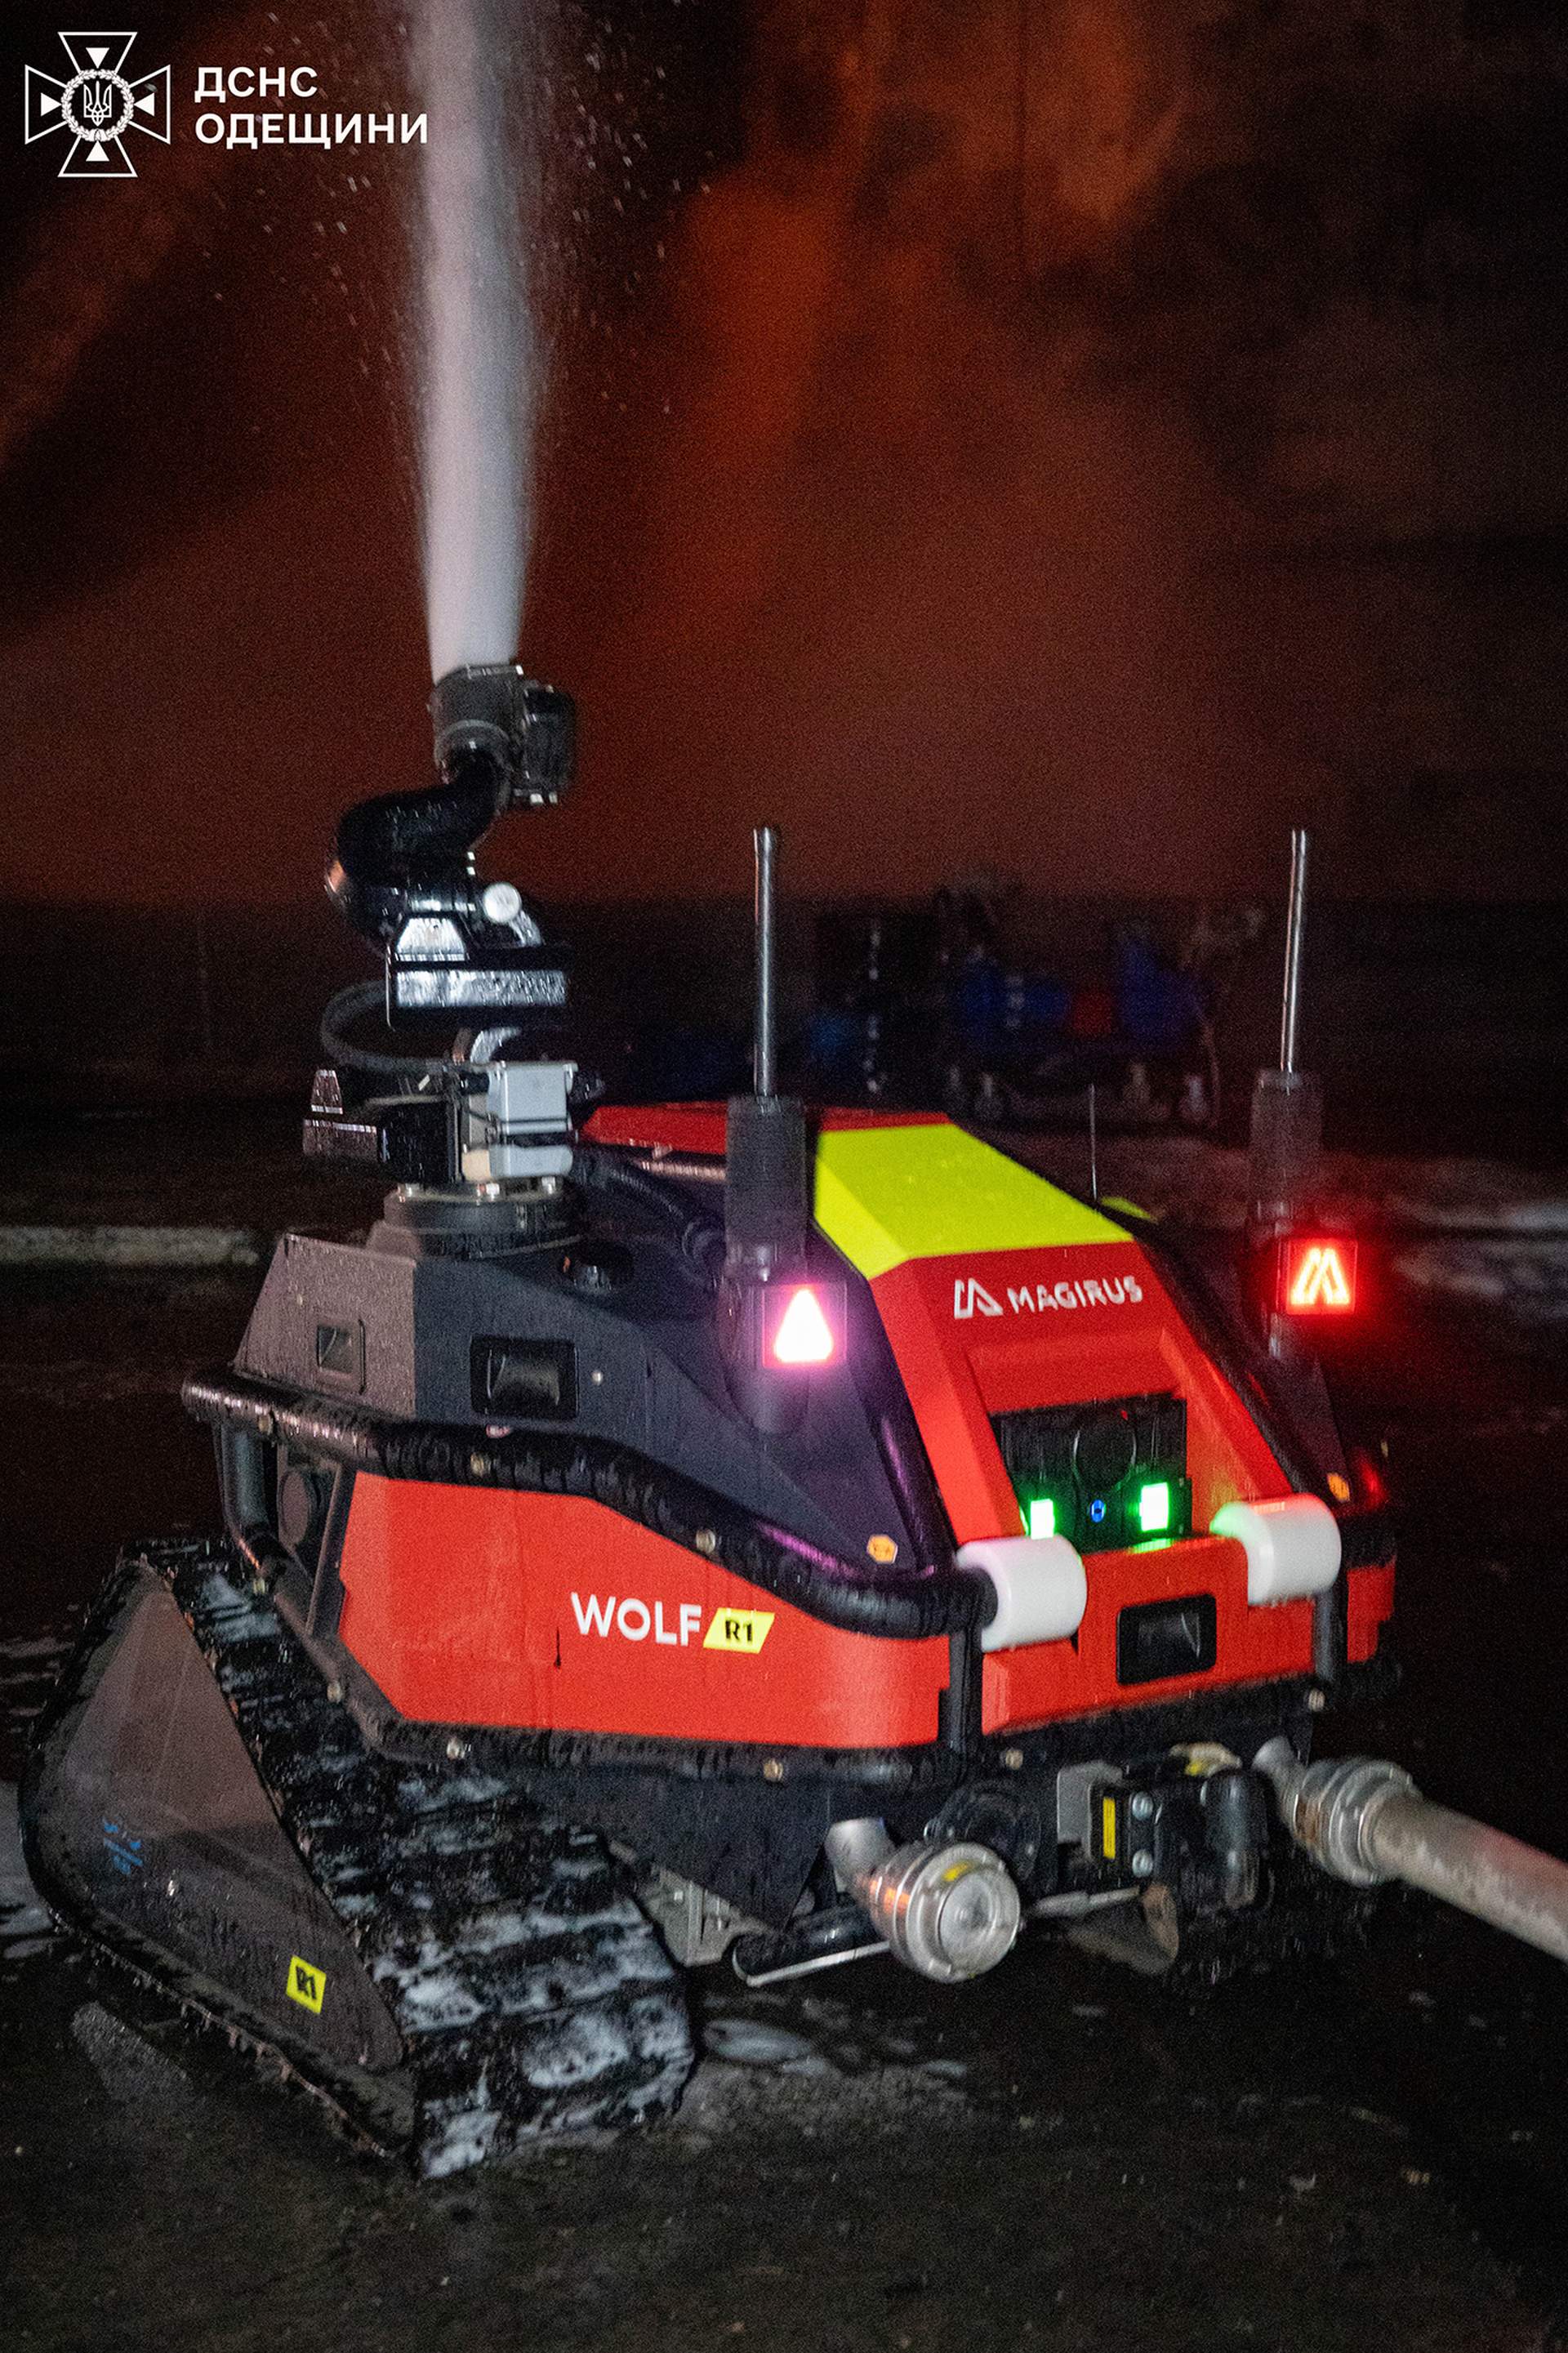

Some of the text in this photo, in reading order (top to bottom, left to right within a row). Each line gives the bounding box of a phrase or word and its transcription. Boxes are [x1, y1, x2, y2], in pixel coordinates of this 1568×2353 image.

[1007, 1275, 1143, 1313] MAGIRUS
[570, 1592, 754, 1647] WOLF R1
[295, 1966, 317, 2000] R1
